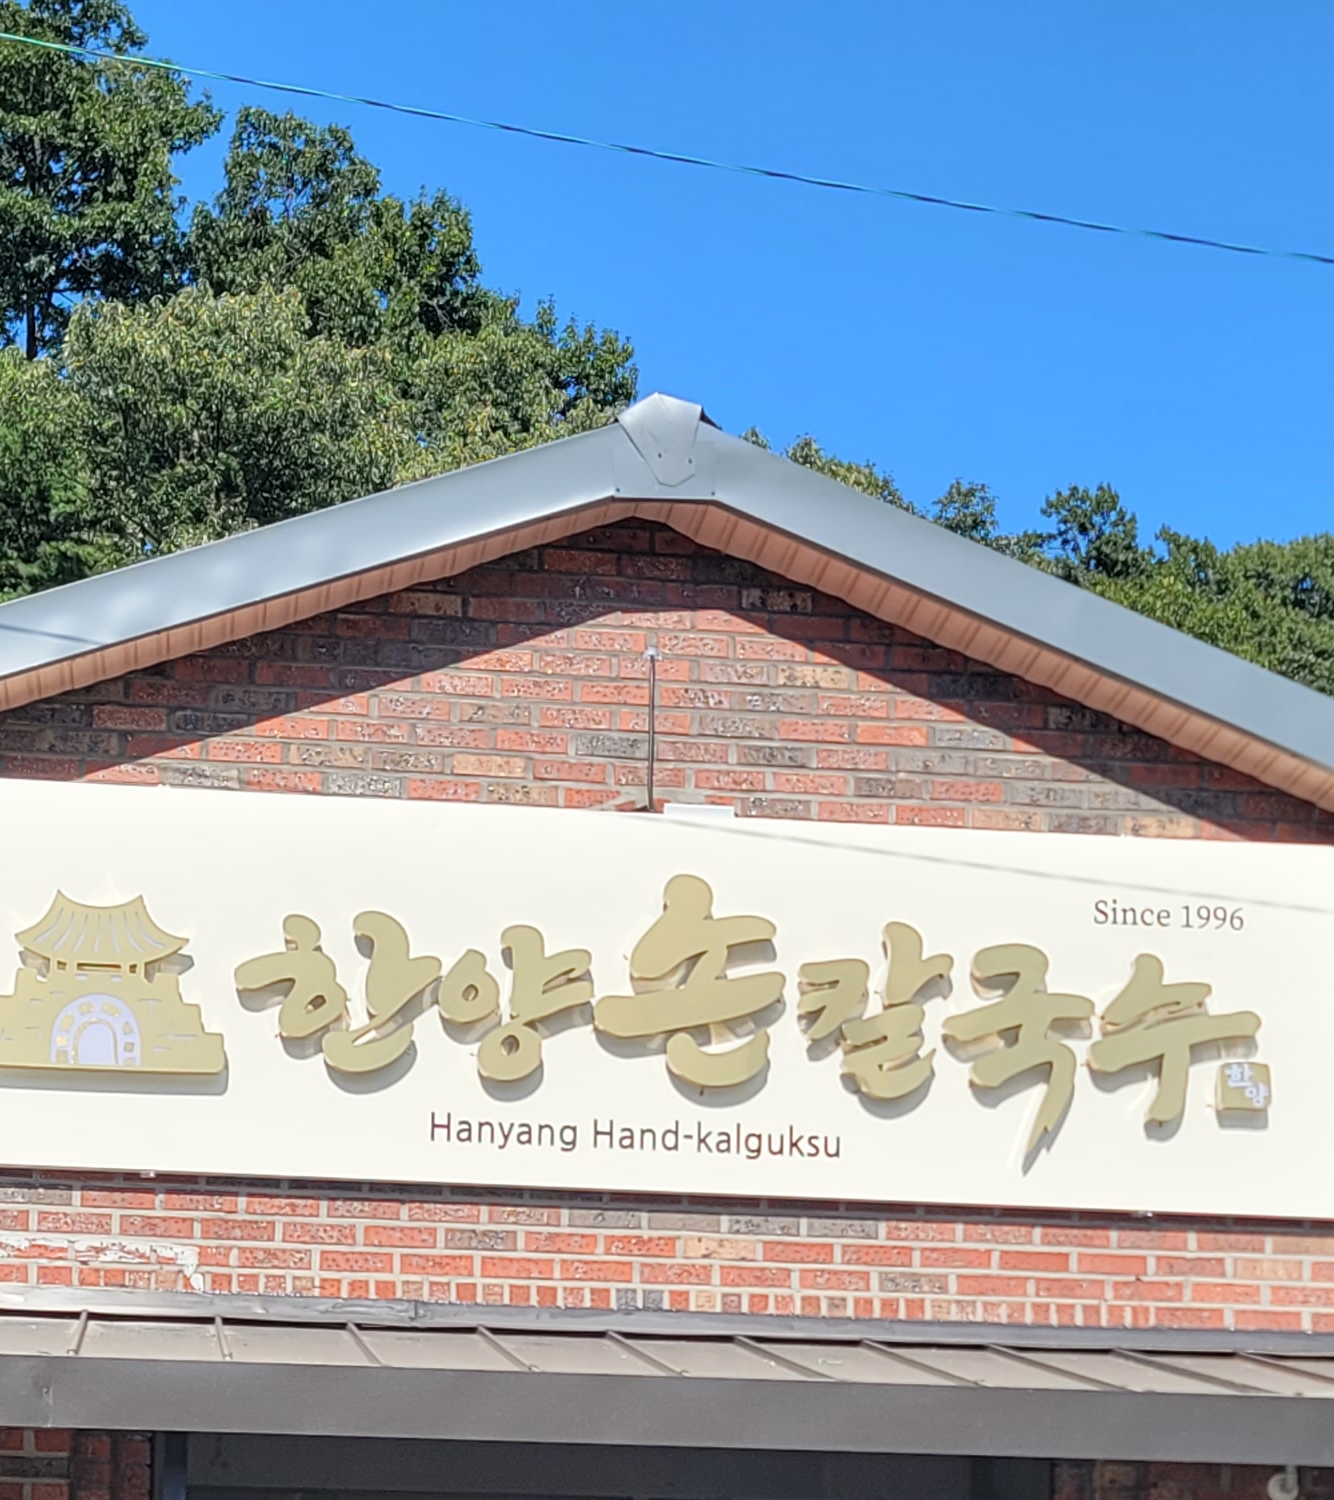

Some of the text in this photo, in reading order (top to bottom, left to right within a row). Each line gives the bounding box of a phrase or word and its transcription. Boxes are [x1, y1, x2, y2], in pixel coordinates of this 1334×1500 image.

[1093, 898, 1245, 932] Since 1996
[429, 1111, 842, 1160] Hanyang Hand-kalguksu
